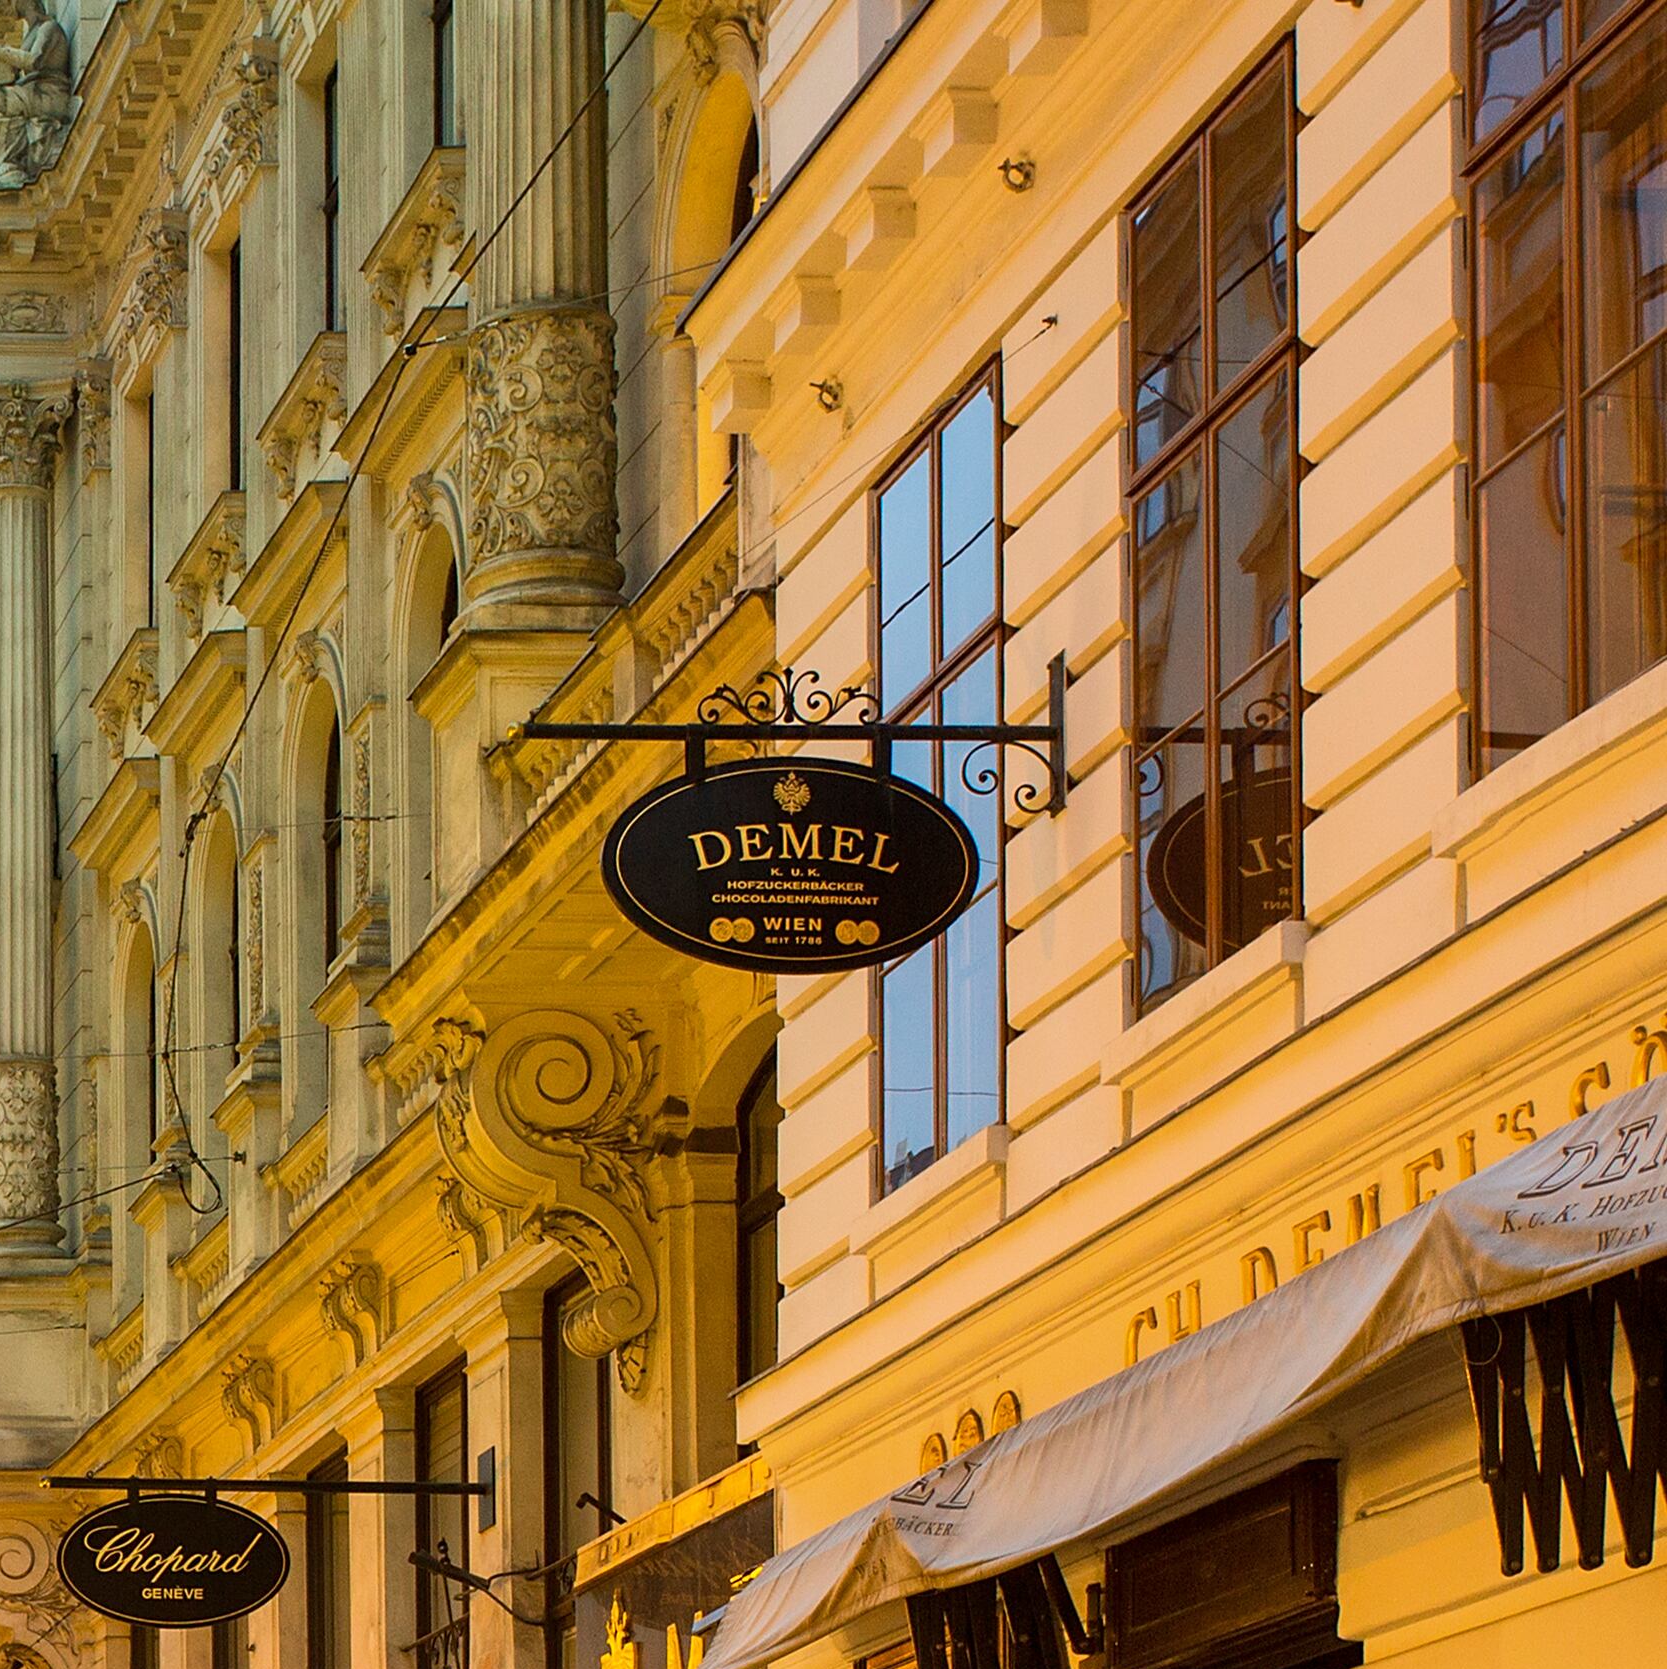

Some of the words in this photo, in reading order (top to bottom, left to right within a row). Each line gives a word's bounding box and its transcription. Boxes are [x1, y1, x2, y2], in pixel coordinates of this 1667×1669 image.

[686, 822, 901, 875] DEMEL
[770, 867, 784, 877] K.
[790, 867, 804, 877] U.
[807, 867, 821, 877] K.
[726, 879, 865, 892] HOFZUCKERBÄCKER
[711, 893, 880, 905] CHOCOLADENFABRIKANT
[762, 917, 823, 931] WIEN
[765, 936, 789, 945] SEIT
[1596, 1221, 1657, 1254] WIEN
[83, 1525, 264, 1583] Chopard
[141, 1586, 204, 1600] GENÈVE
